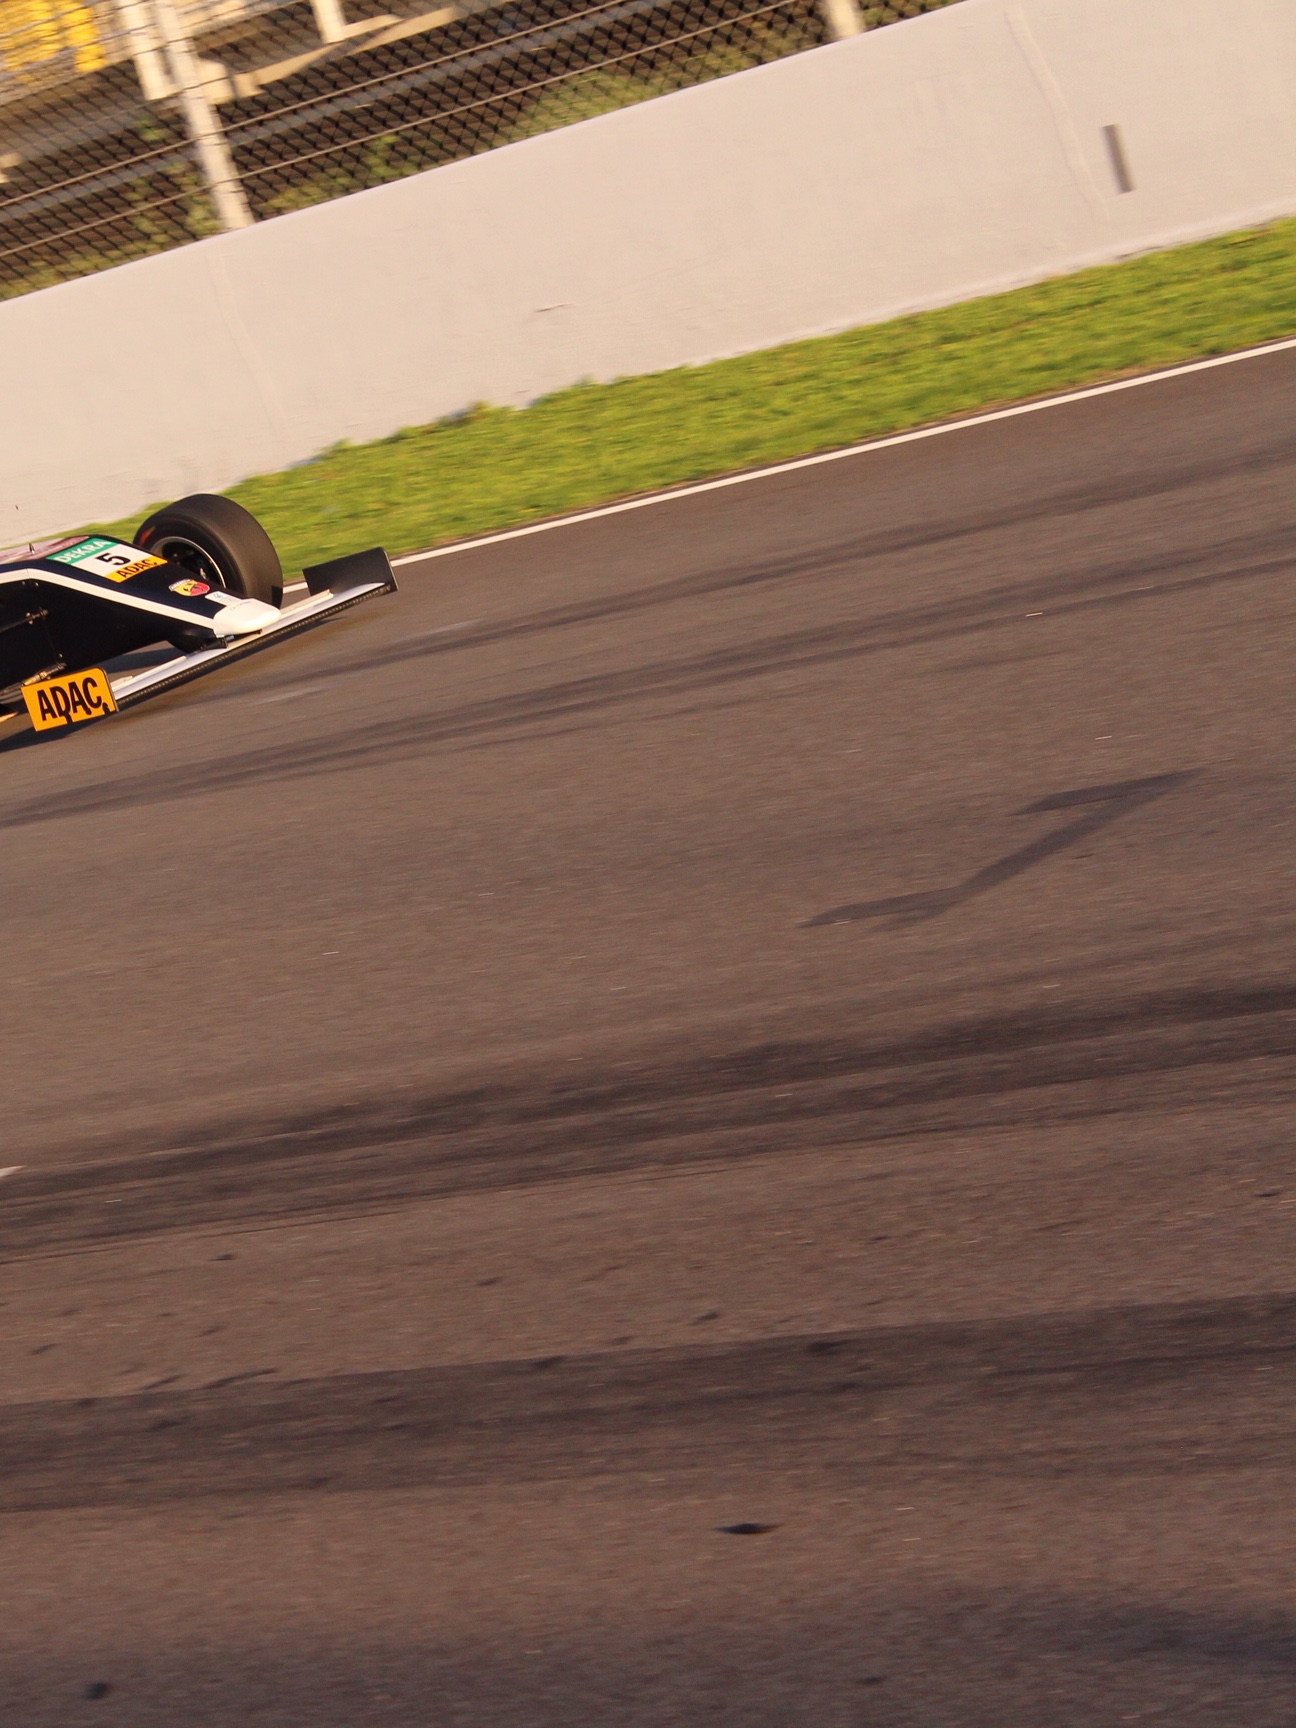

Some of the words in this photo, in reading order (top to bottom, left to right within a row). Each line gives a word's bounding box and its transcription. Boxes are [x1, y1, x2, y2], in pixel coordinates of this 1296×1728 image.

[53, 540, 112, 563] DEKRA
[95, 552, 131, 565] 5
[116, 559, 158, 578] ADAC
[37, 677, 103, 722] ADAC
